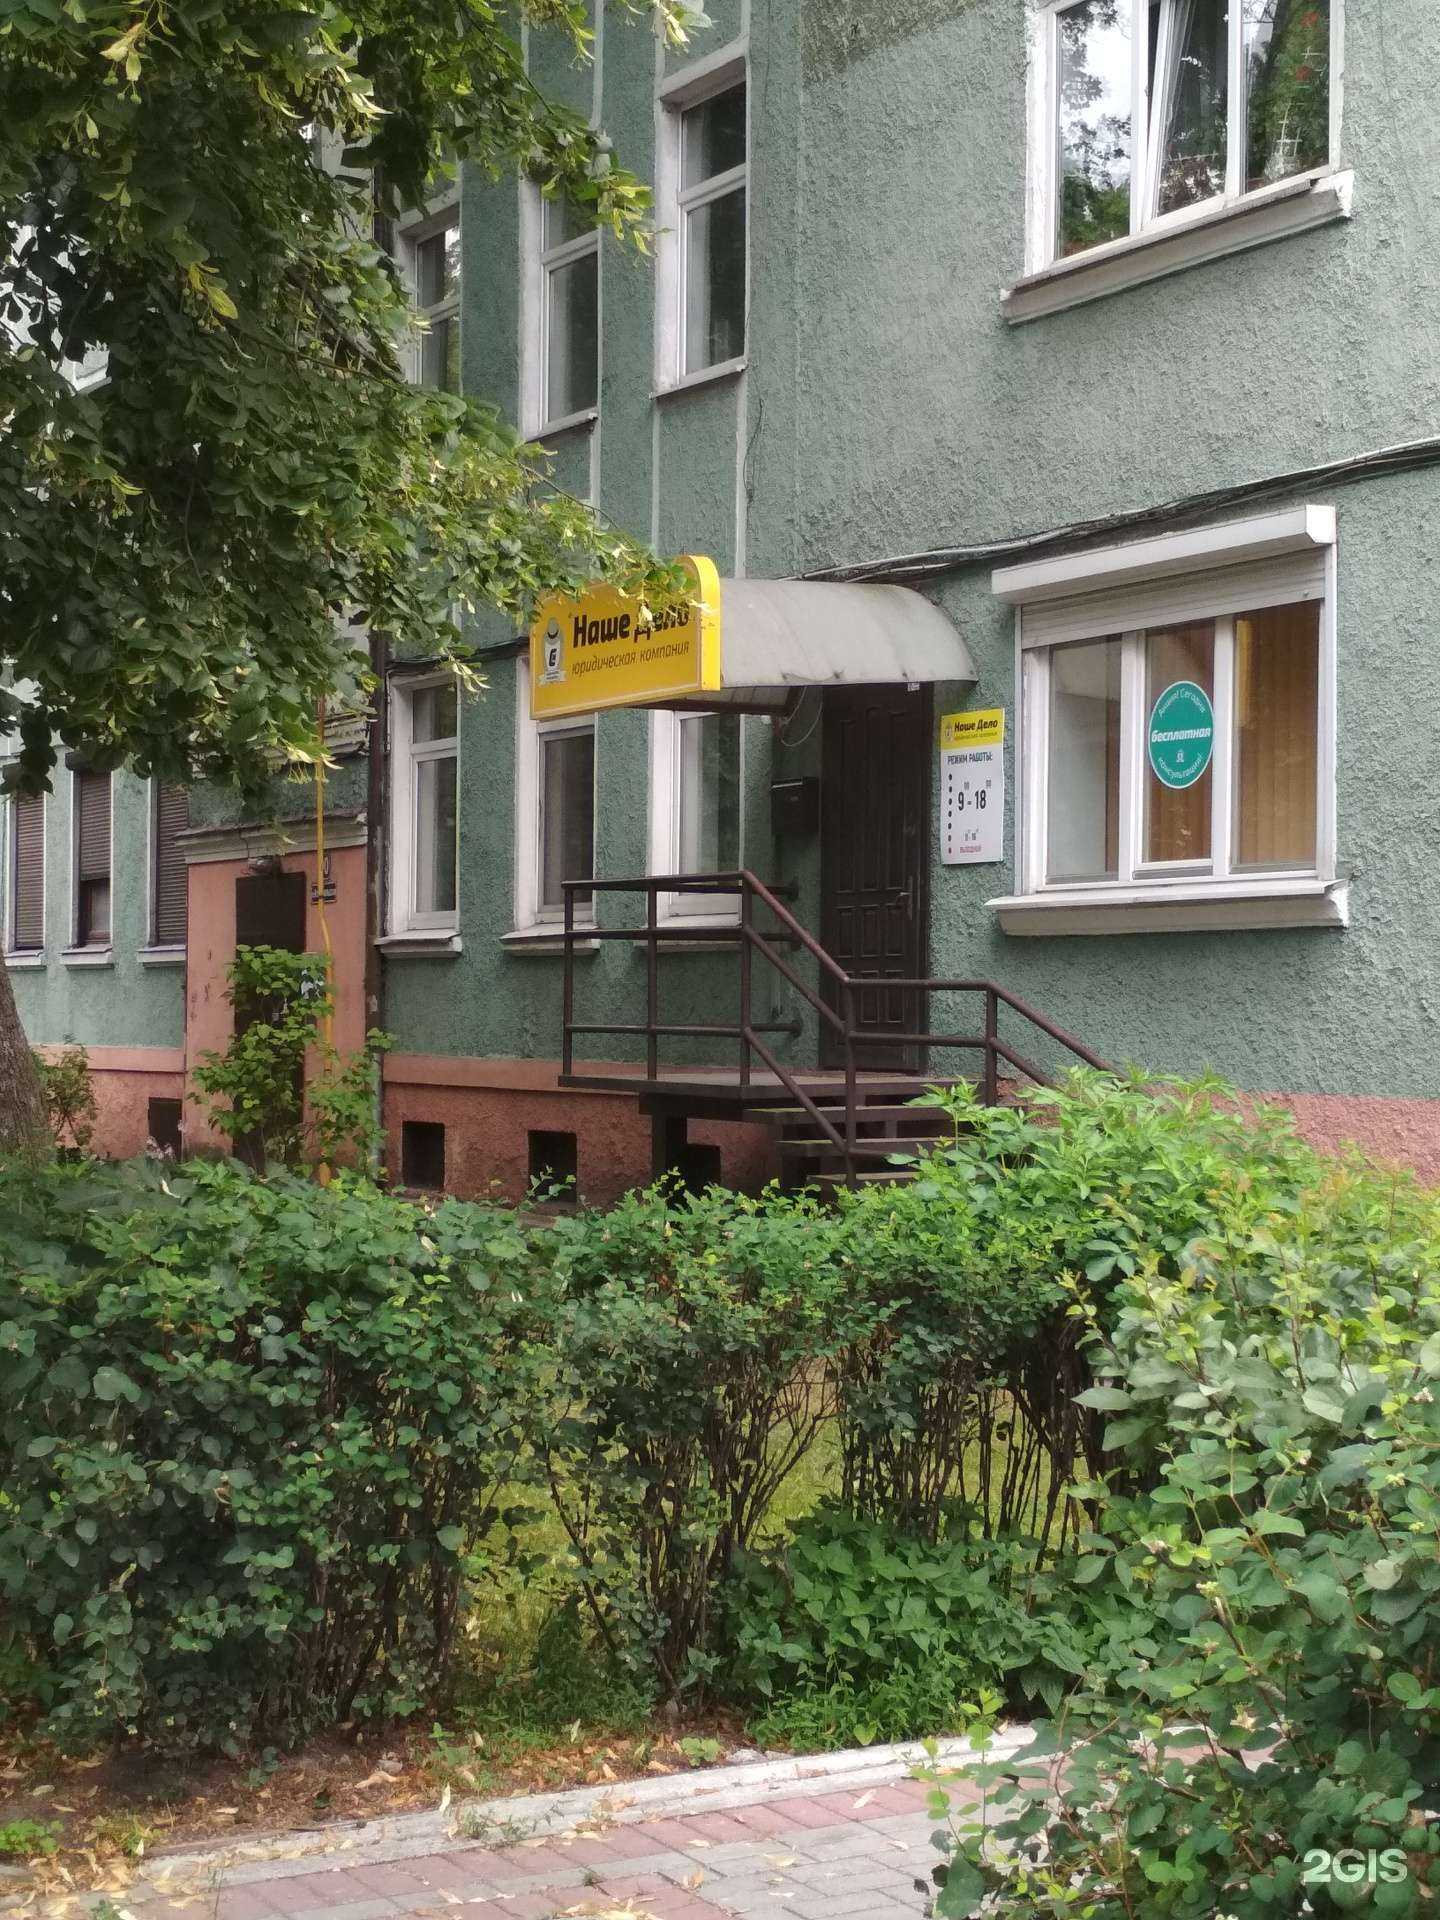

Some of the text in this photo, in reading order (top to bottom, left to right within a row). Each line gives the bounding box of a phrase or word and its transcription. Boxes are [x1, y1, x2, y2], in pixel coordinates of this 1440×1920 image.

[573, 613, 631, 648] Наше
[571, 653, 637, 678] юридическая
[640, 641, 690, 665] компания
[954, 719, 998, 732] Наше Дело
[1151, 727, 1212, 743] бесплатная
[947, 752, 993, 765] РЕЖИМ РАБОТЫ:
[958, 791, 965, 811] 9
[974, 789, 987, 810] 18
